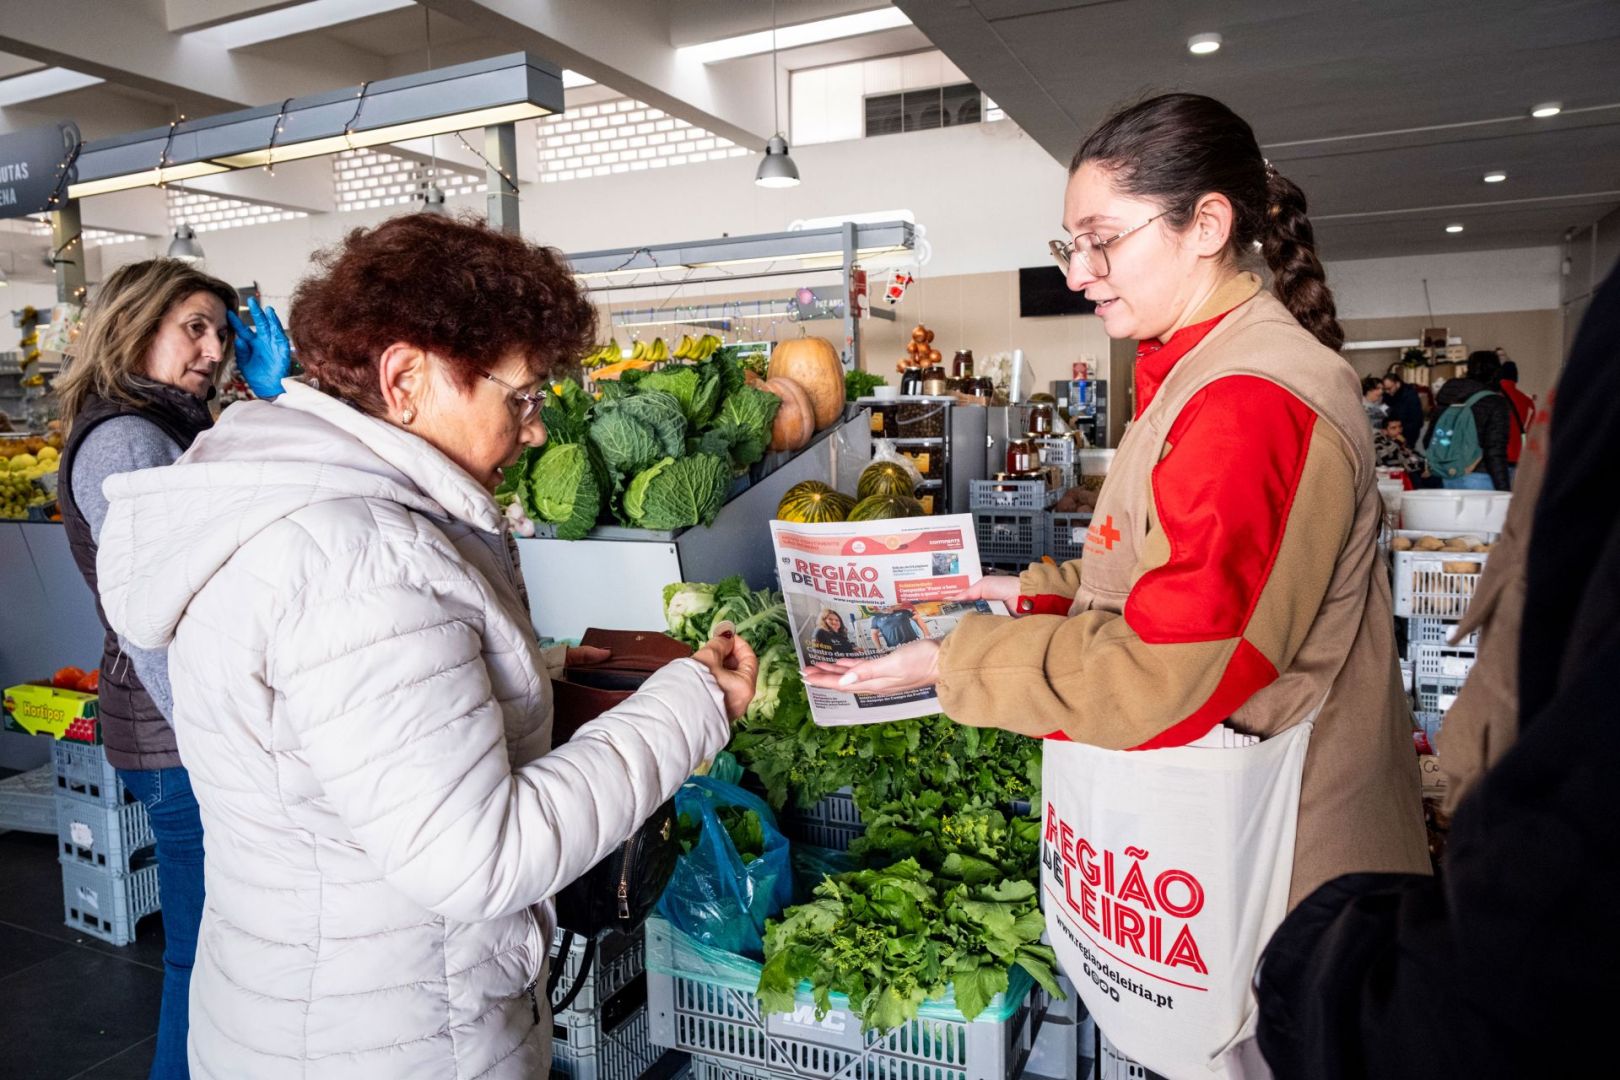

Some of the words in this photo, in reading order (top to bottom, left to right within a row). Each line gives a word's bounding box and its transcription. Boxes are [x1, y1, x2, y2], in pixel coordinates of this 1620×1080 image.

[0, 162, 29, 182] UTAS
[795, 559, 879, 582] REGIÃO
[23, 701, 65, 723] Hortipor
[1046, 801, 1205, 919] REGIÃO
[1056, 915, 1174, 1010] www.regiaodeleiria.pt
